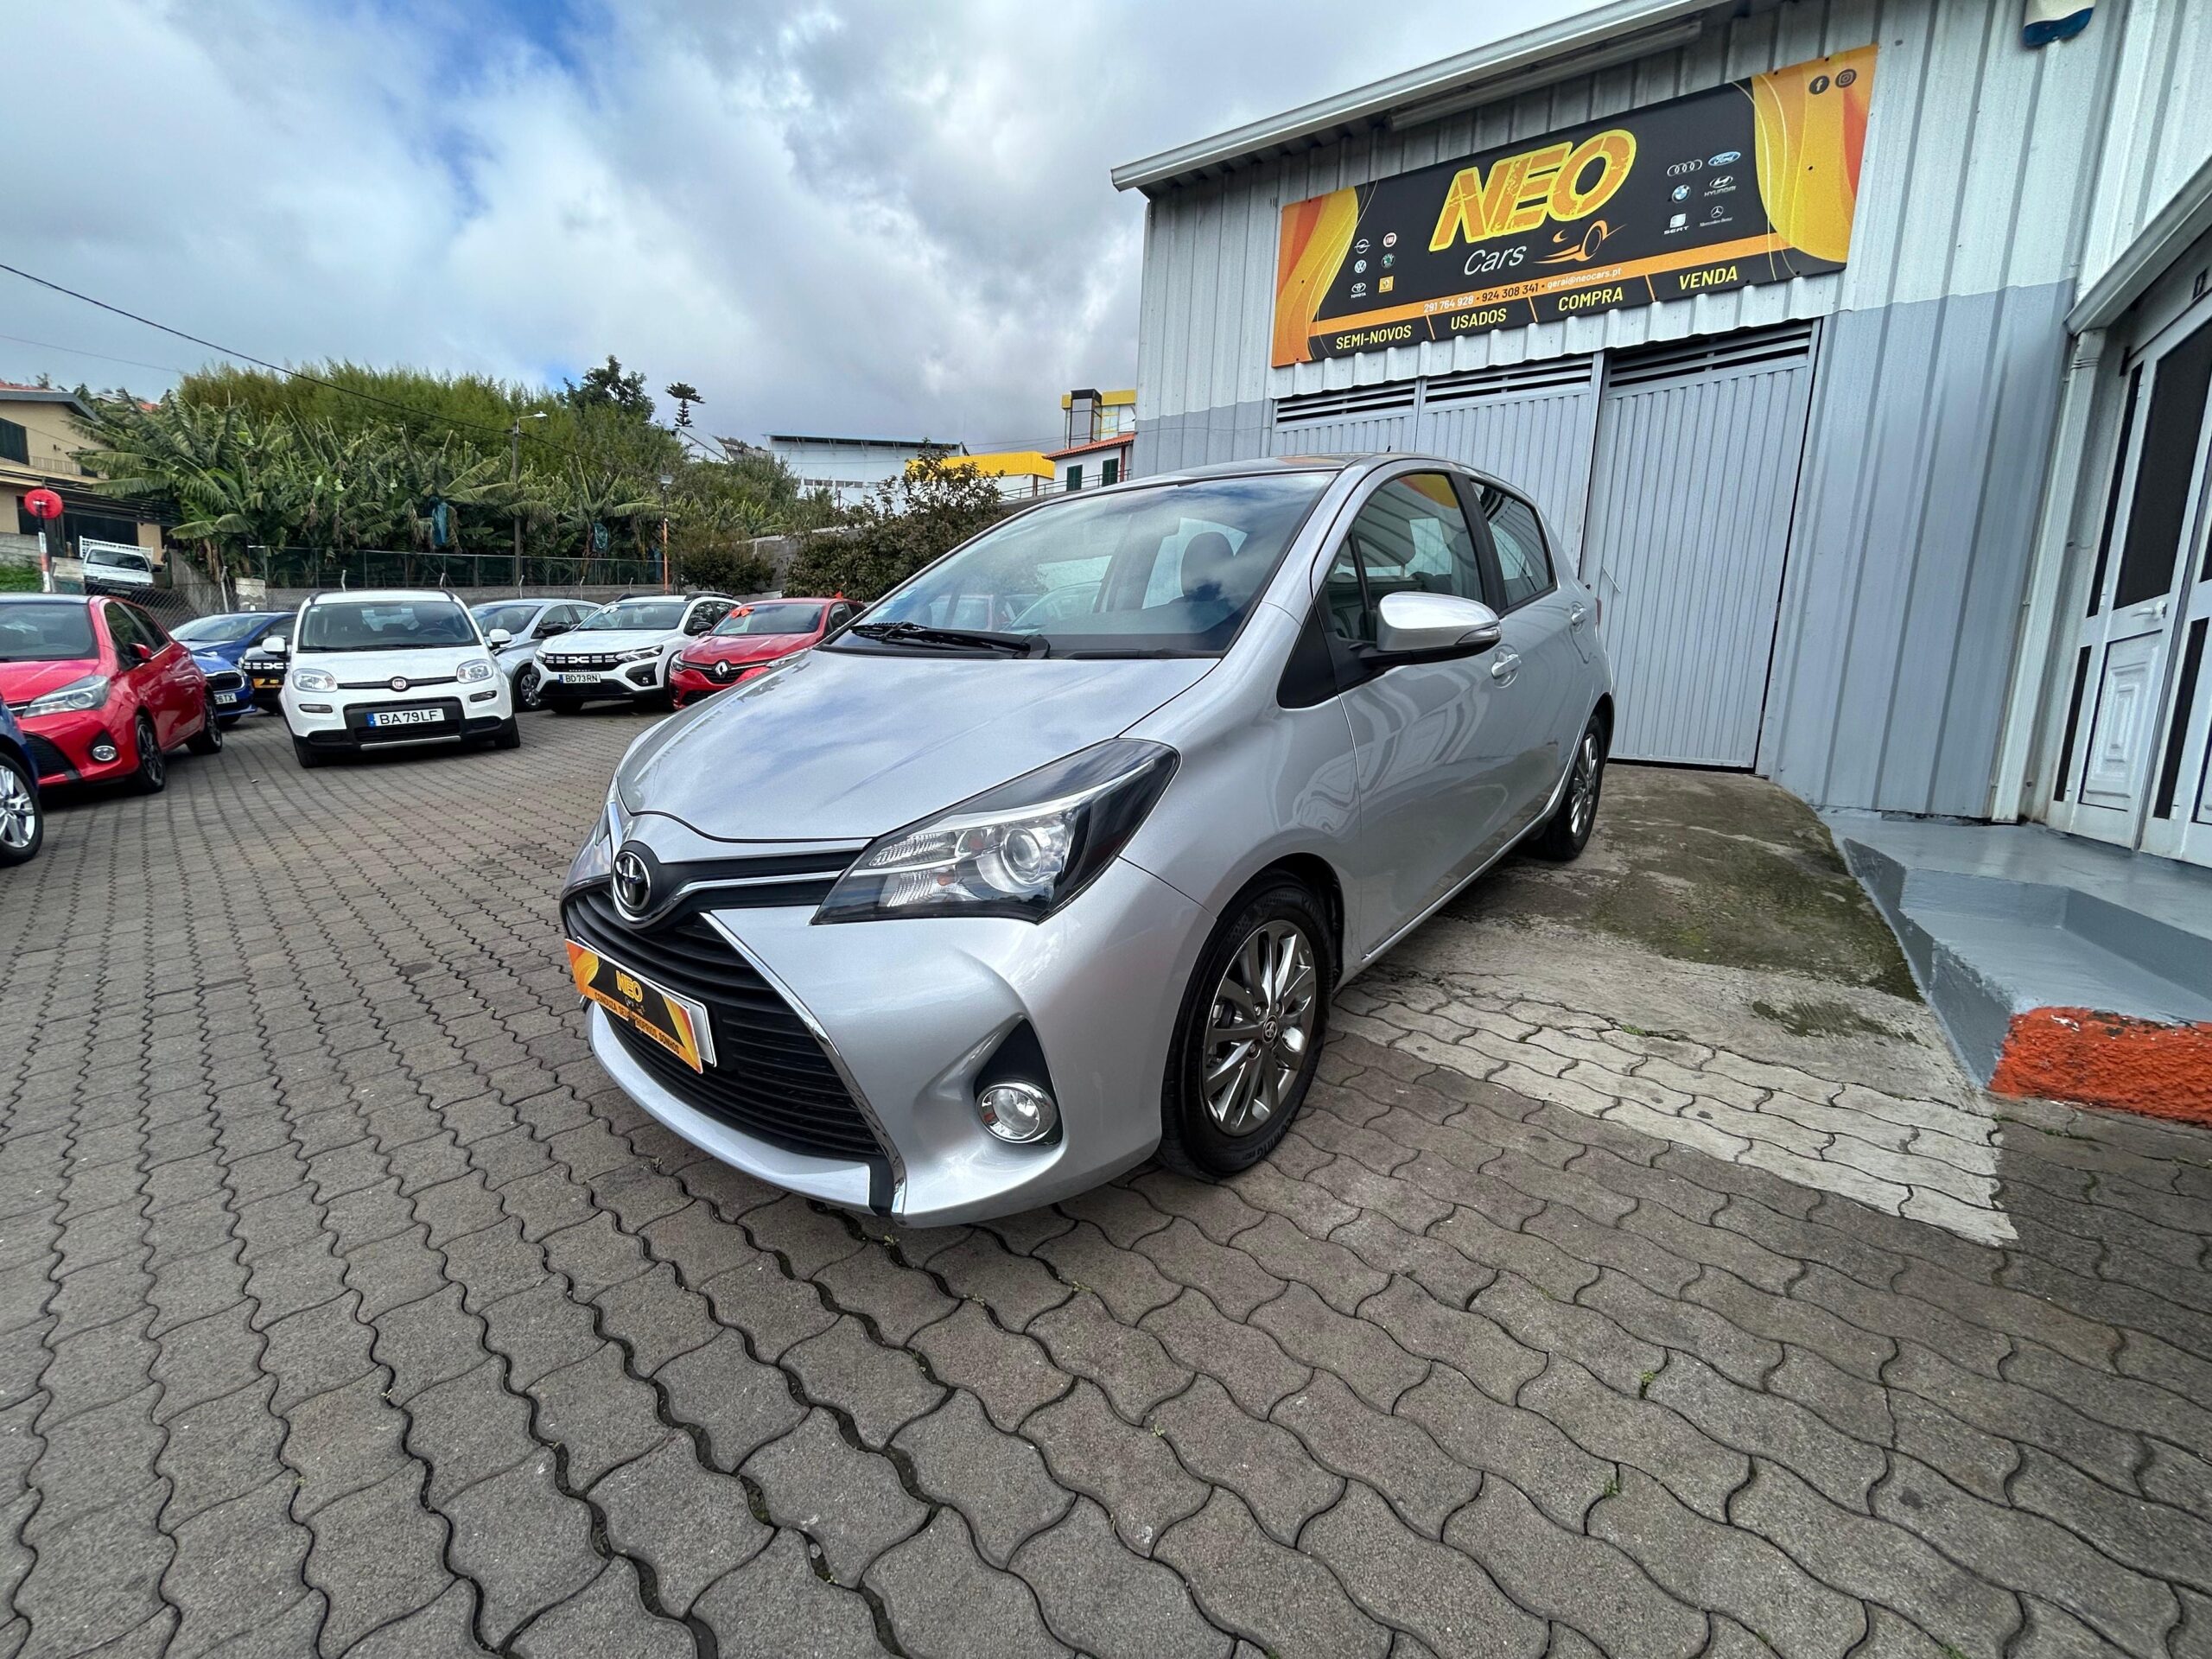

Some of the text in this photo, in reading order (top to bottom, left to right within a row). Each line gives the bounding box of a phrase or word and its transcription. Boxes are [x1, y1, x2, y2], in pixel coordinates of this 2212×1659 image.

[1428, 129, 1637, 252] NEO
[1663, 226, 1689, 235] SEAT
[1464, 245, 1528, 276] Cars
[1440, 300, 1455, 309] 764
[1482, 291, 1499, 302] 924
[1502, 286, 1520, 298] 308
[1522, 283, 1538, 295] 341
[1547, 267, 1623, 290] geral@neocars.pt
[1679, 265, 1738, 289] VENDA
[1558, 287, 1624, 312] COMPRA
[1451, 308, 1507, 330] USADOS
[1336, 325, 1412, 349] SEMI-NOVOS
[379, 710, 437, 724] BA79LF
[615, 969, 643, 1002] NEO
